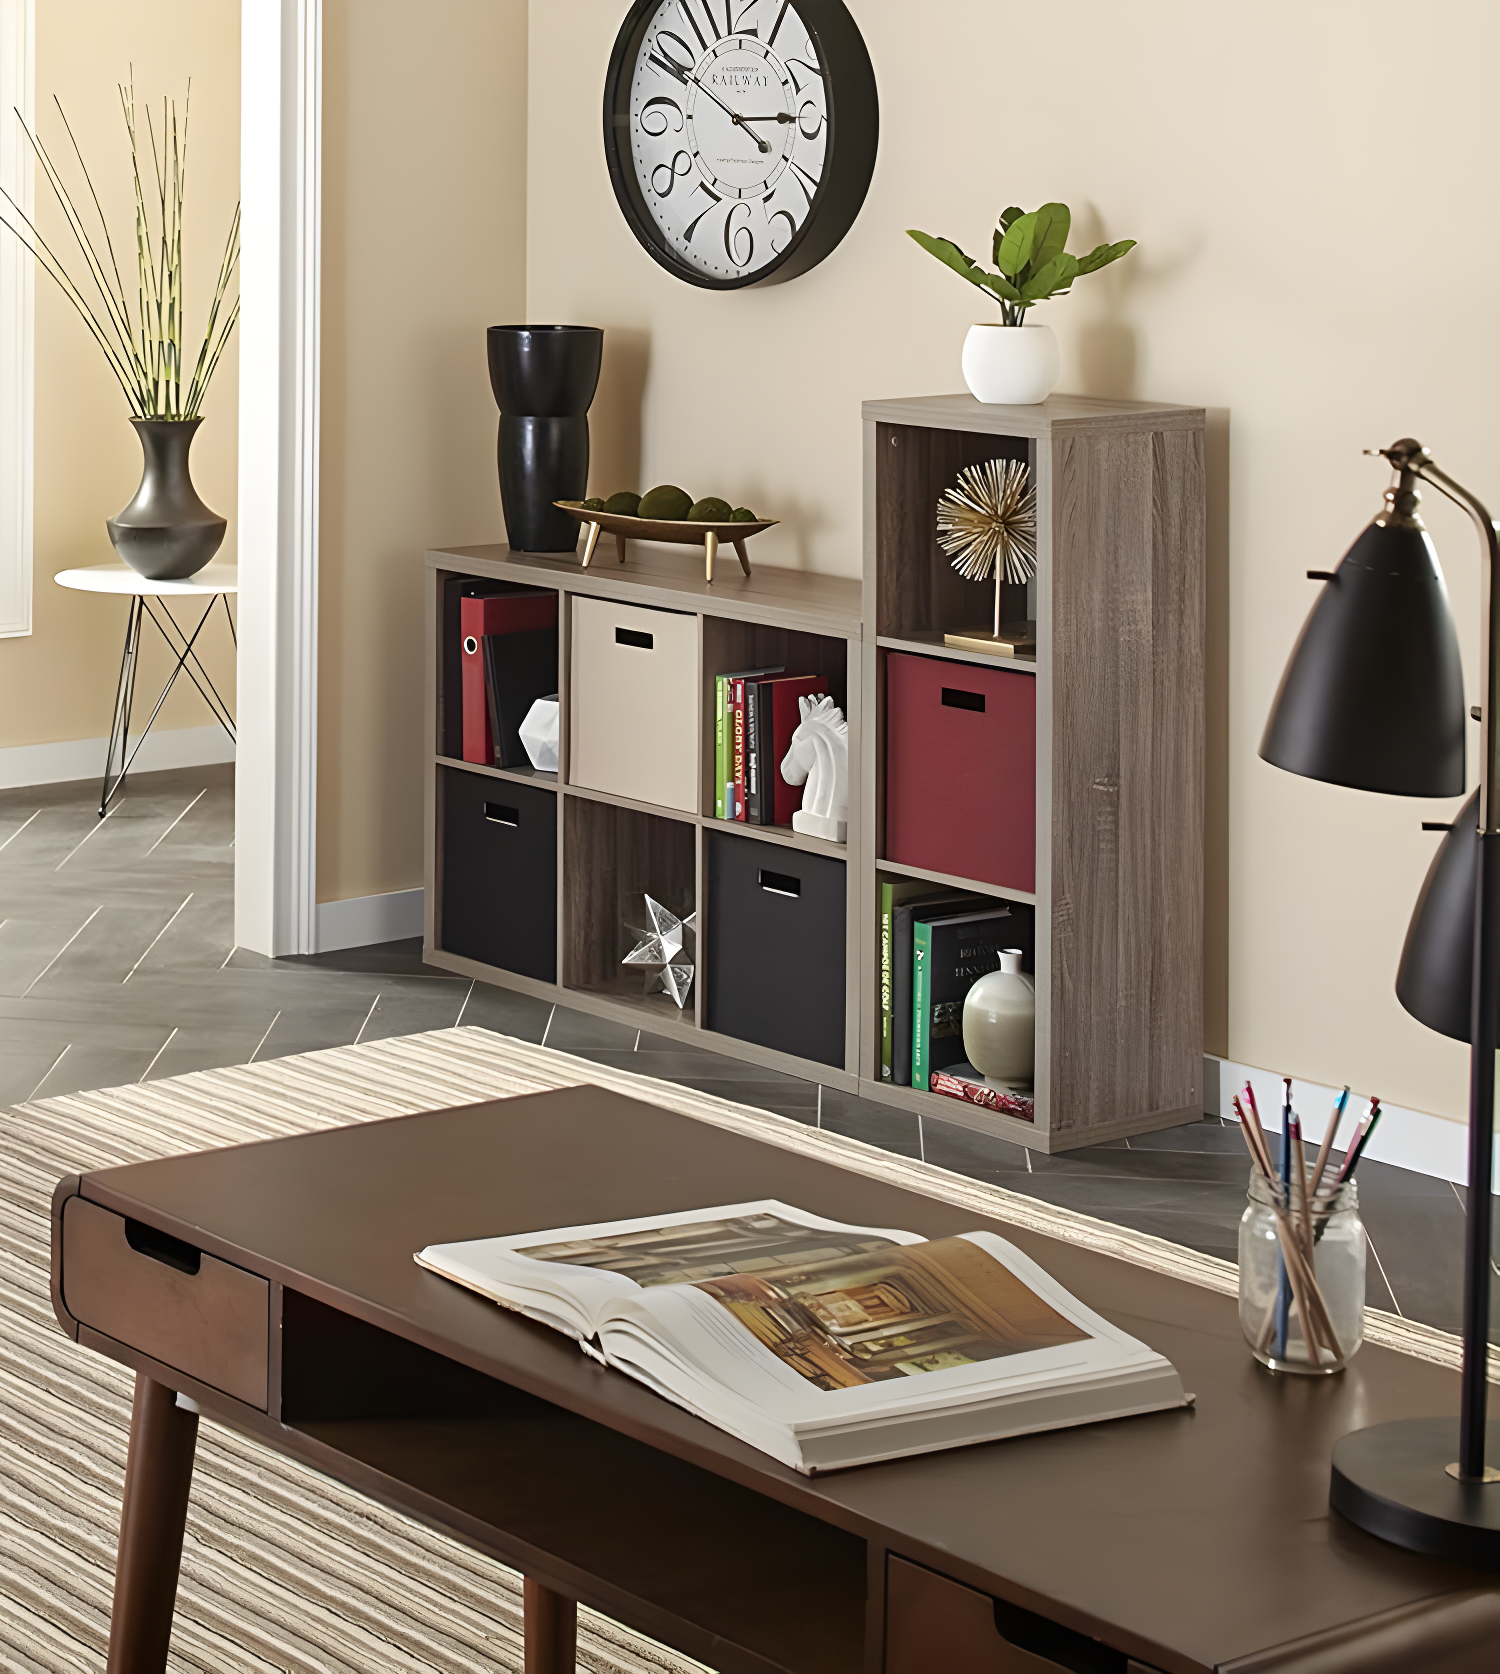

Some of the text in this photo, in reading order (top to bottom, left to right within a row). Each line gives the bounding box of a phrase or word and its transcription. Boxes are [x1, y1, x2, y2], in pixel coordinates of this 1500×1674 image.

[711, 73, 769, 88] RAILWAY
[640, 96, 684, 137] 9
[651, 149, 692, 199] 8
[683, 180, 723, 245] 7
[723, 202, 754, 268] 6
